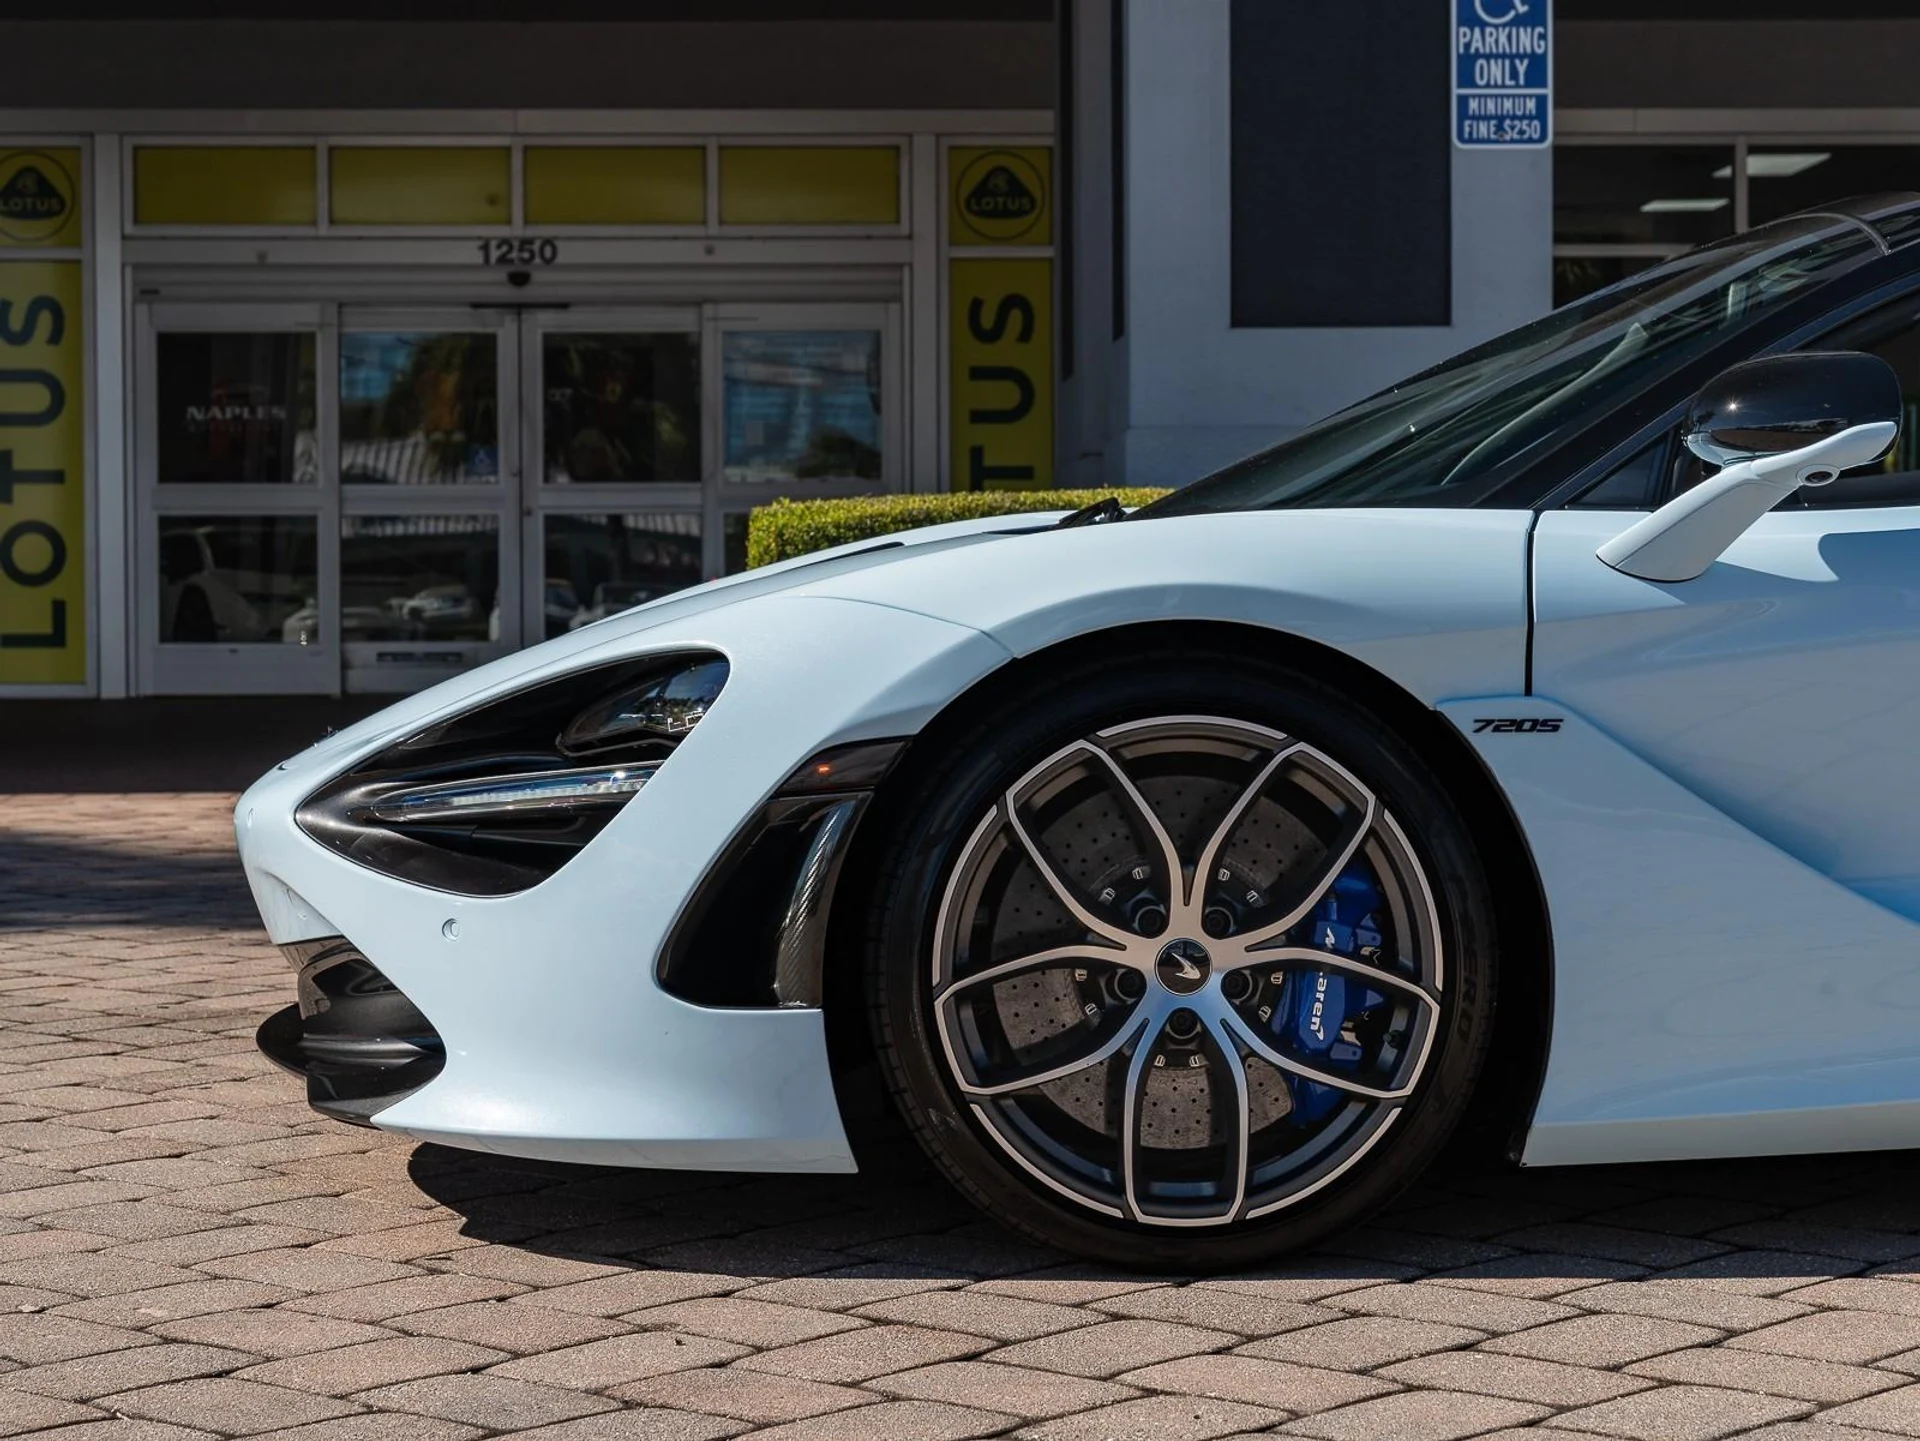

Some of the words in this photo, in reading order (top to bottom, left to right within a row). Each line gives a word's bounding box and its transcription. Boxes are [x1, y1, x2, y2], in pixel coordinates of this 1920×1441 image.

[1458, 26, 1546, 54] PARKING
[1475, 58, 1529, 86] ONLY
[1468, 97, 1536, 116] MINIMUM
[1464, 119, 1498, 139] FINE
[1503, 118, 1541, 141] $250
[0, 196, 62, 212] LOTUS
[969, 195, 1031, 212] LOTUS
[478, 239, 557, 265] 1250
[969, 294, 1034, 491] TUS
[185, 405, 287, 421] NAPLES
[0, 294, 67, 649] LOTUS
[1473, 718, 1564, 733] 720S
